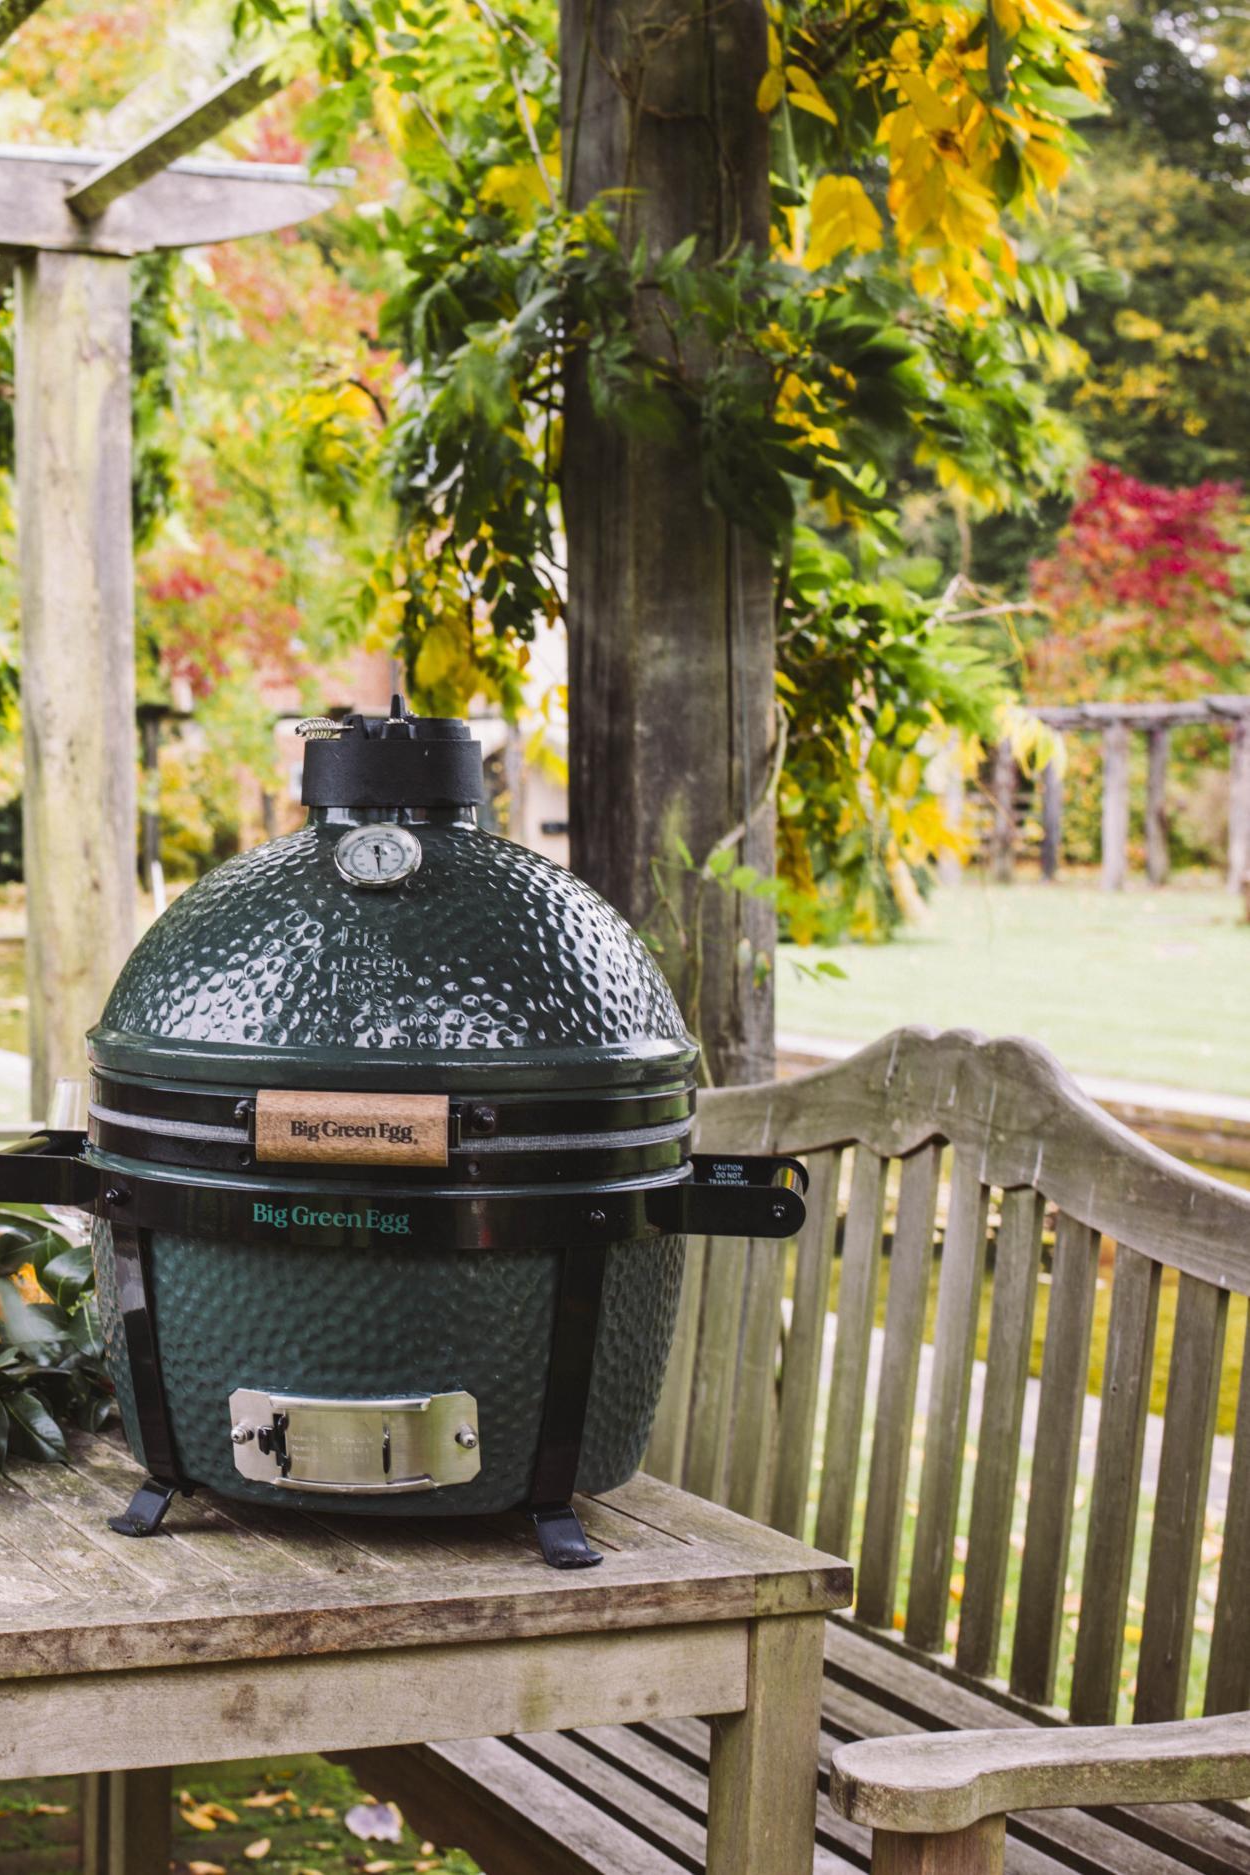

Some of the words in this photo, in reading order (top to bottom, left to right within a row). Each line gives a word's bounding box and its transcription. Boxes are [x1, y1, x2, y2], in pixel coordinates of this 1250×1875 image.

[313, 950, 412, 977] Green
[291, 1121, 320, 1141] Big
[322, 1121, 376, 1138] Green
[379, 1123, 414, 1144] Egg
[712, 1163, 743, 1171] CAUTION
[715, 1171, 726, 1179] DO
[727, 1172, 742, 1180] NOT
[253, 1203, 288, 1229] Big
[291, 1206, 362, 1228] Green
[366, 1209, 410, 1234] Egg
